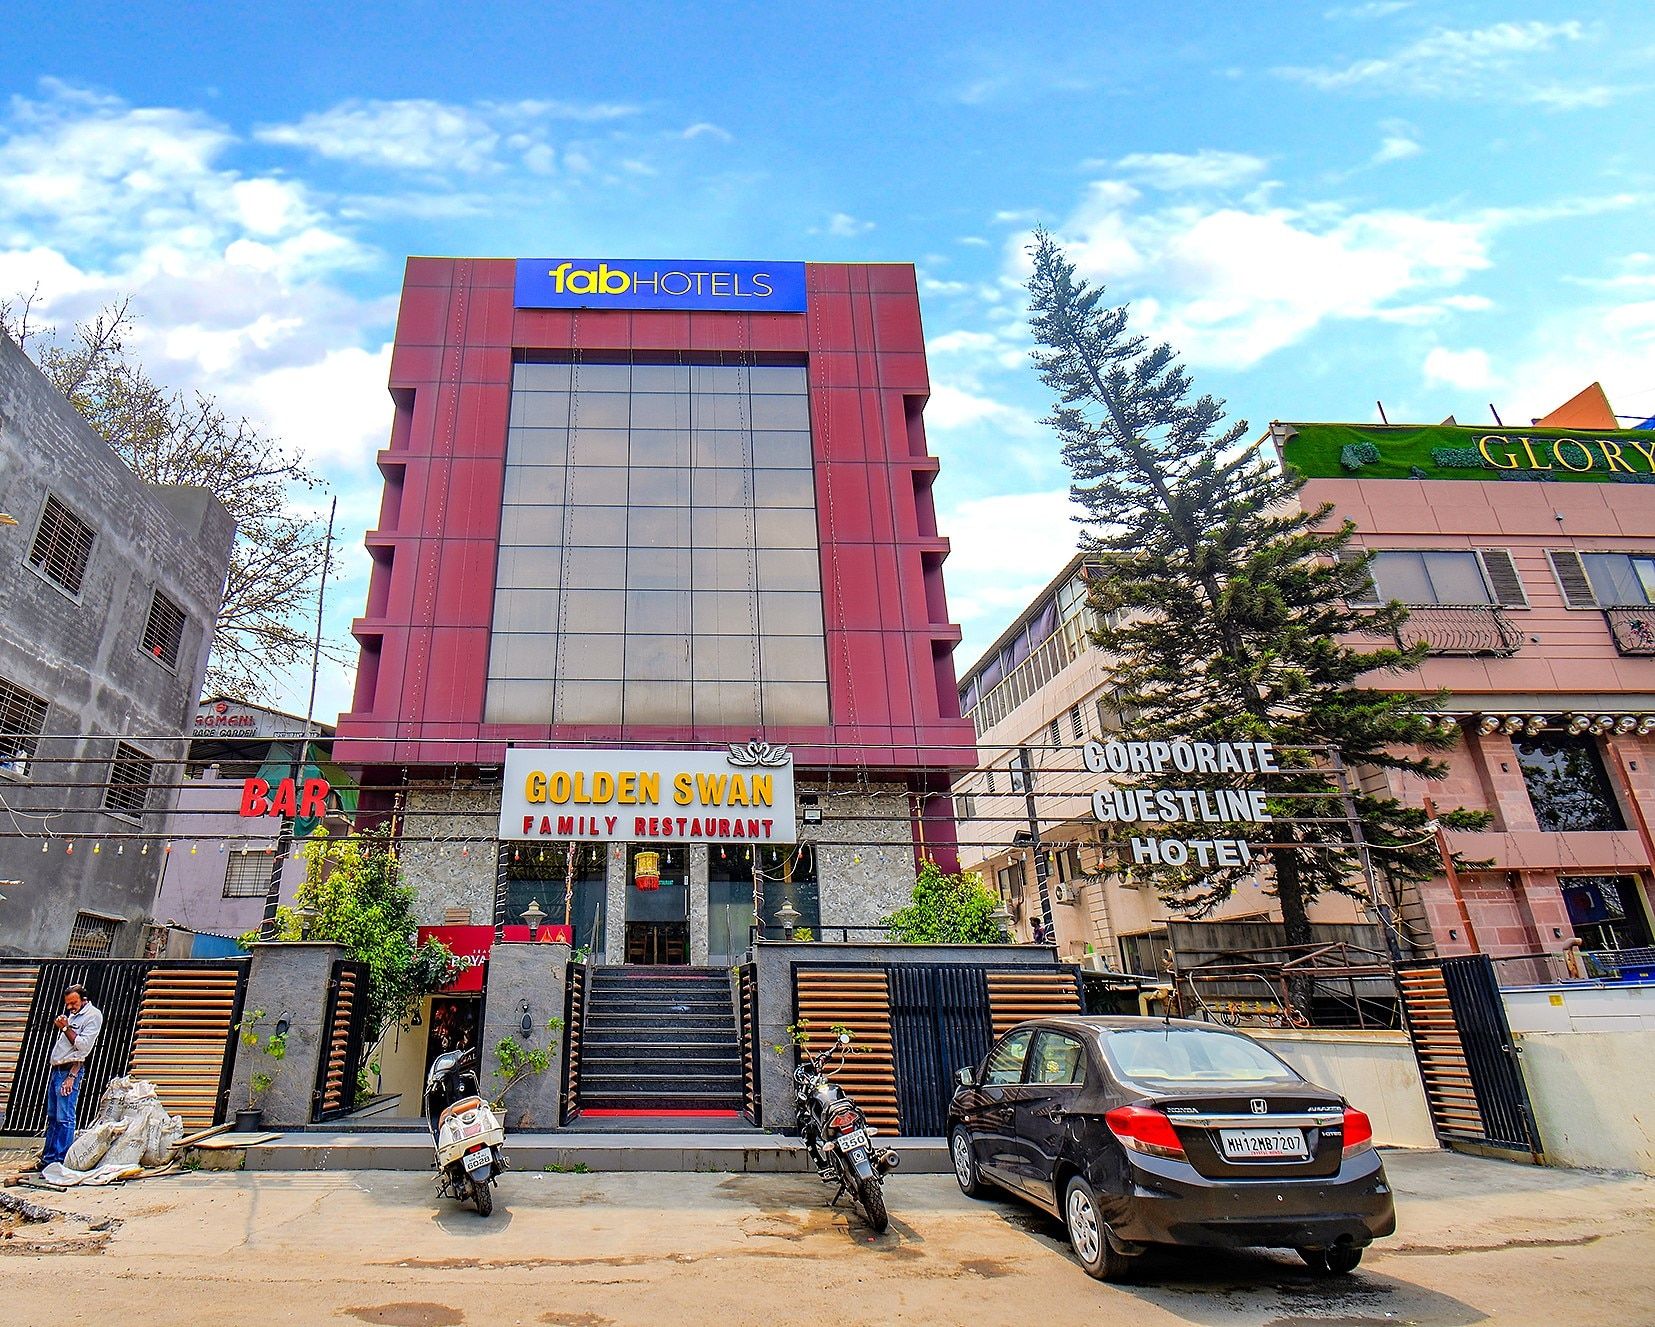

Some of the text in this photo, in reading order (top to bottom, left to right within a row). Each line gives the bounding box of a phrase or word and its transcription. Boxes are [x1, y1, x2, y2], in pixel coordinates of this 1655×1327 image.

[1479, 435, 1655, 473] GLORY
[1083, 741, 1279, 773] CORPORATE
[240, 777, 330, 818] BAR
[525, 770, 773, 806] GOLDEN SWAN
[1091, 788, 1273, 823] GUESTLINE
[523, 815, 774, 838] FAMILY RESTAURANT
[841, 1135, 865, 1149] 350
[1227, 1136, 1301, 1152] MH12MB7207
[467, 1156, 490, 1169] 6028
